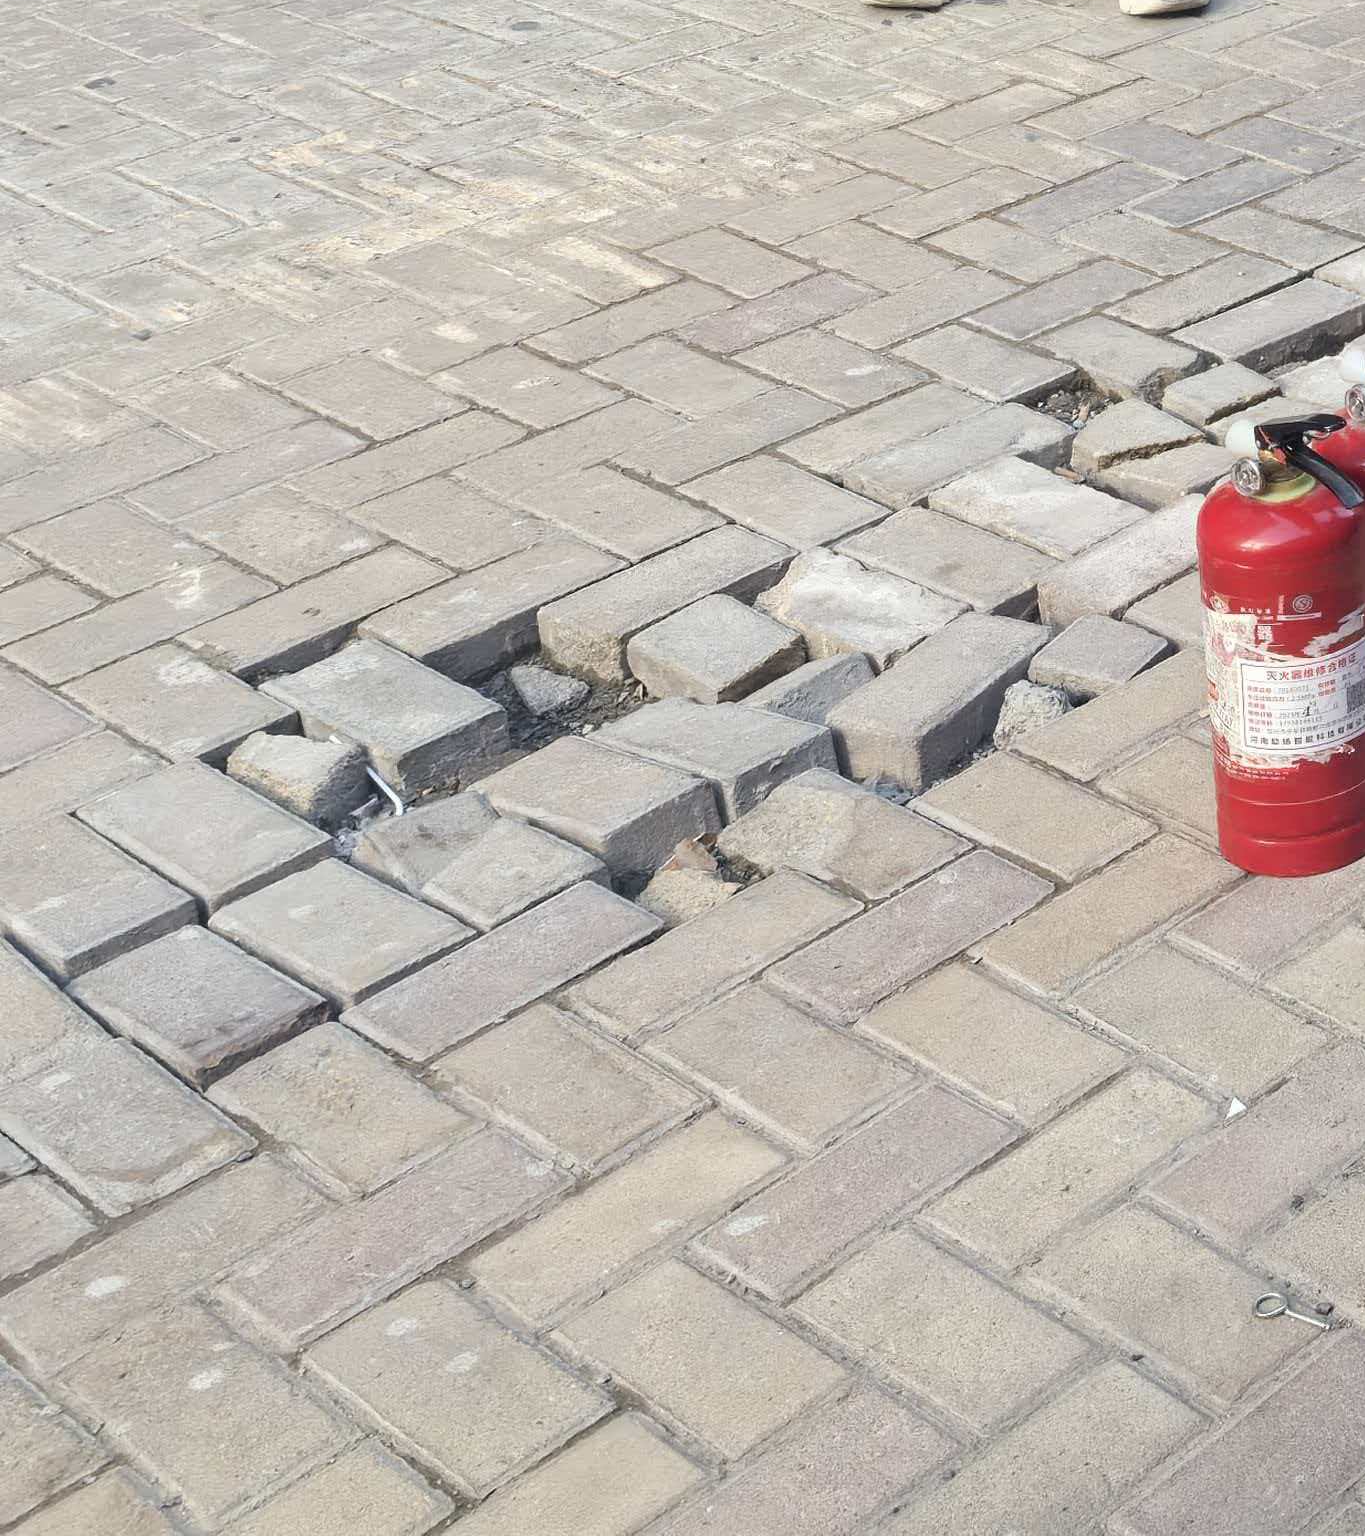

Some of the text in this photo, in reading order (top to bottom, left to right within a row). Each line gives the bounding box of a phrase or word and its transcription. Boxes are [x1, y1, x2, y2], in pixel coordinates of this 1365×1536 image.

[1266, 654, 1356, 681] 灭火器维修合格证
